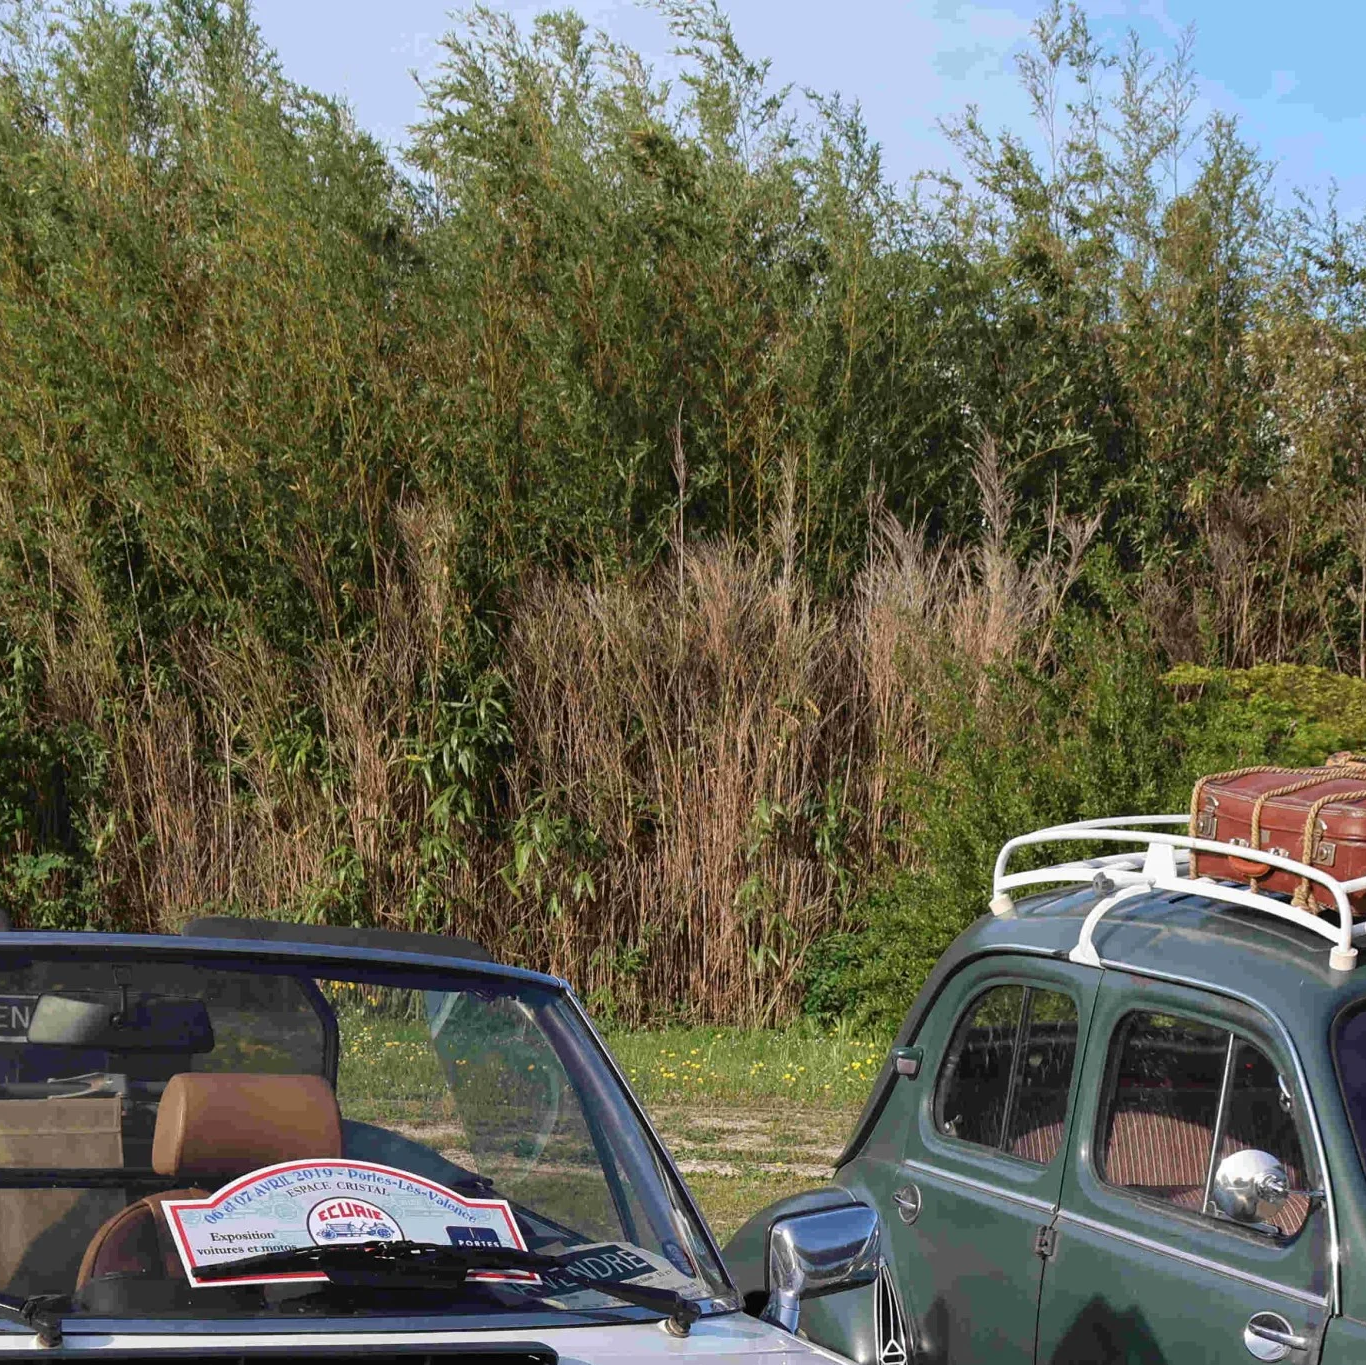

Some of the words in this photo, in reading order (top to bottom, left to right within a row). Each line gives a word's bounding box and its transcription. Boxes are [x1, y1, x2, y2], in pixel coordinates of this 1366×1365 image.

[205, 1210, 224, 1224] 06
[224, 1201, 234, 1213] et
[235, 1191, 252, 1207] 07
[254, 1175, 294, 1197] AVRIL
[293, 1168, 333, 1181] 2019
[286, 1181, 333, 1198] ESPACE
[336, 1181, 391, 1197] CRISTAL
[317, 1202, 384, 1222] ECURIE
[210, 1230, 276, 1243] Exposition
[197, 1245, 244, 1256] voitures
[248, 1245, 259, 1254] et
[260, 1244, 298, 1253] motos
